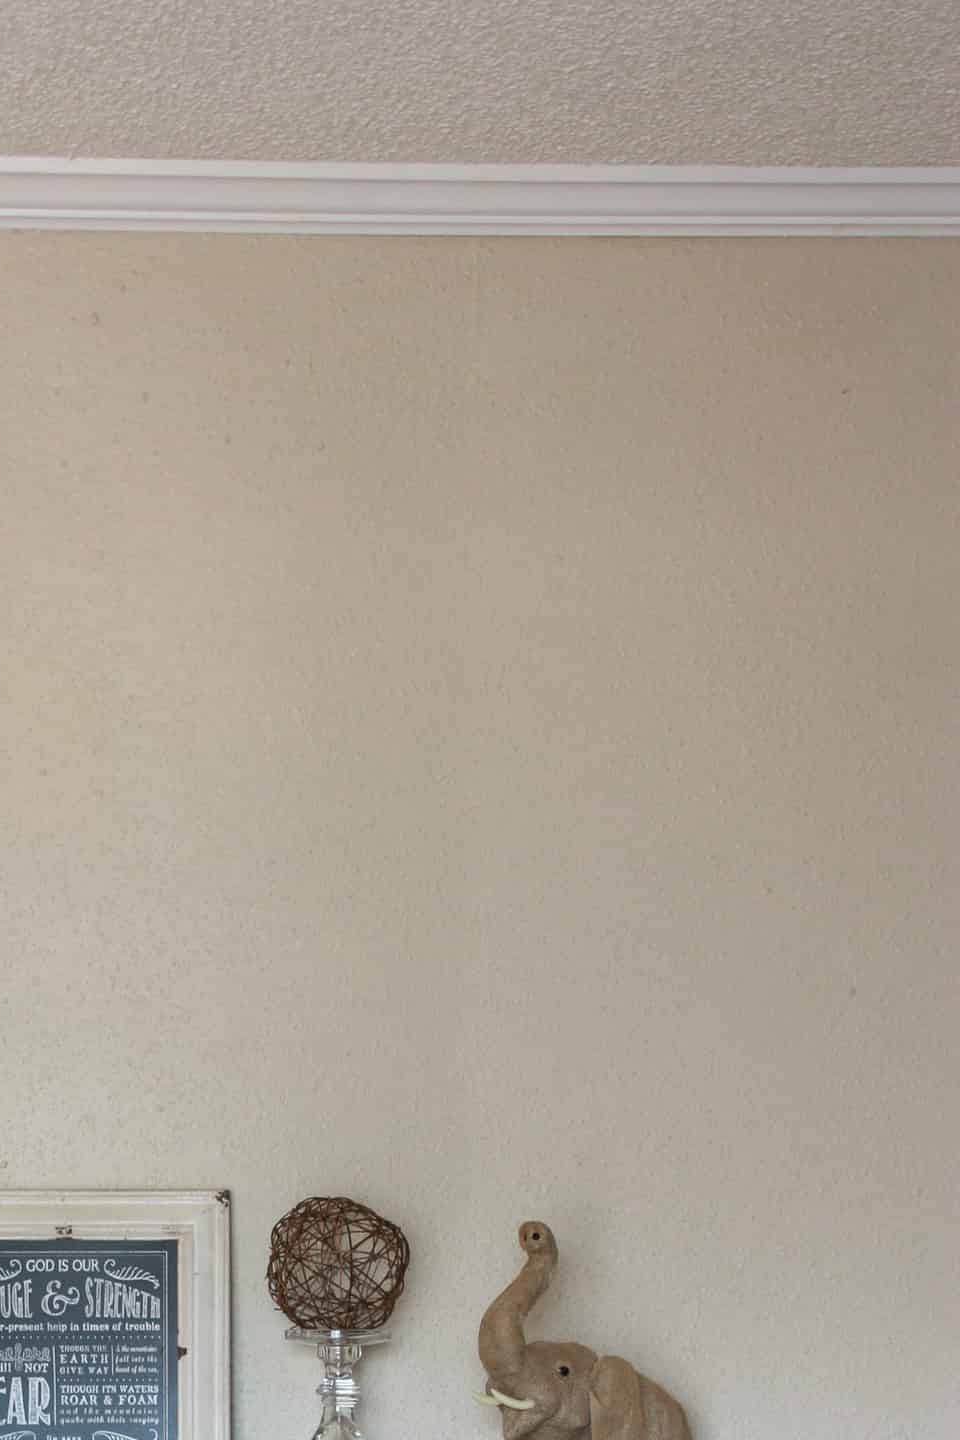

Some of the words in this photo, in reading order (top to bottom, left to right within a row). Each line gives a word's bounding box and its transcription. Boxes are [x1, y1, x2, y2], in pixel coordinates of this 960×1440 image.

[26, 1259, 54, 1272] GOD
[58, 1259, 69, 1272] IS
[72, 1259, 100, 1272] OUR
[41, 1280, 80, 1316] &
[85, 1277, 160, 1318] STRENGTH
[70, 1322, 79, 1331] in
[83, 1322, 108, 1331] times
[112, 1322, 122, 1331] of
[125, 1322, 160, 1331] trouble
[60, 1353, 108, 1364] EARTH
[24, 1363, 48, 1372] NOT
[60, 1385, 98, 1393] THOUGH
[102, 1385, 116, 1393] ITS
[120, 1385, 159, 1393] WATERS
[61, 1395, 97, 1405] ROAR
[104, 1395, 112, 1405] &
[119, 1395, 158, 1405] FOAM
